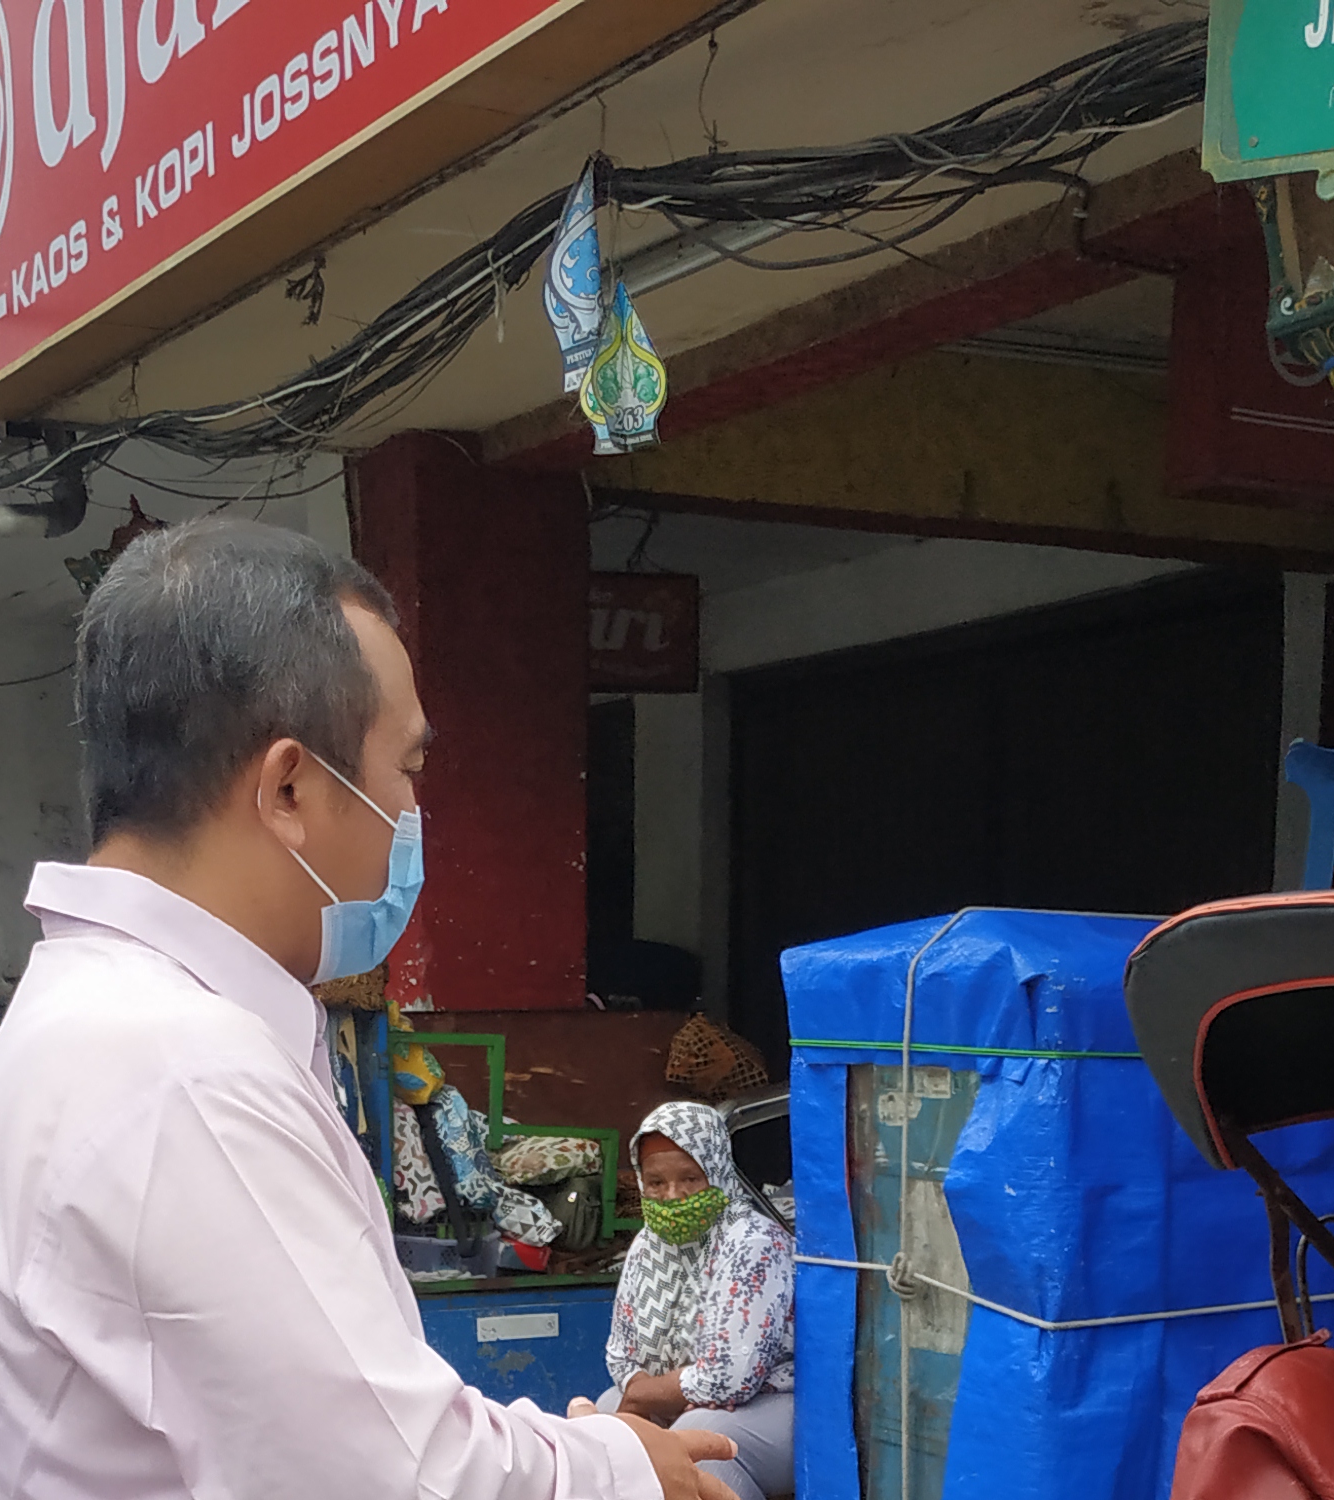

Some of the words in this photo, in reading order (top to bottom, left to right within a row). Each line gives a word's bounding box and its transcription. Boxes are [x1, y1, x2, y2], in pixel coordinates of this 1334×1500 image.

[11, 220, 88, 314] KAOS
[101, 195, 124, 251] &
[135, 122, 215, 228] KOPI
[613, 404, 644, 432] 263
